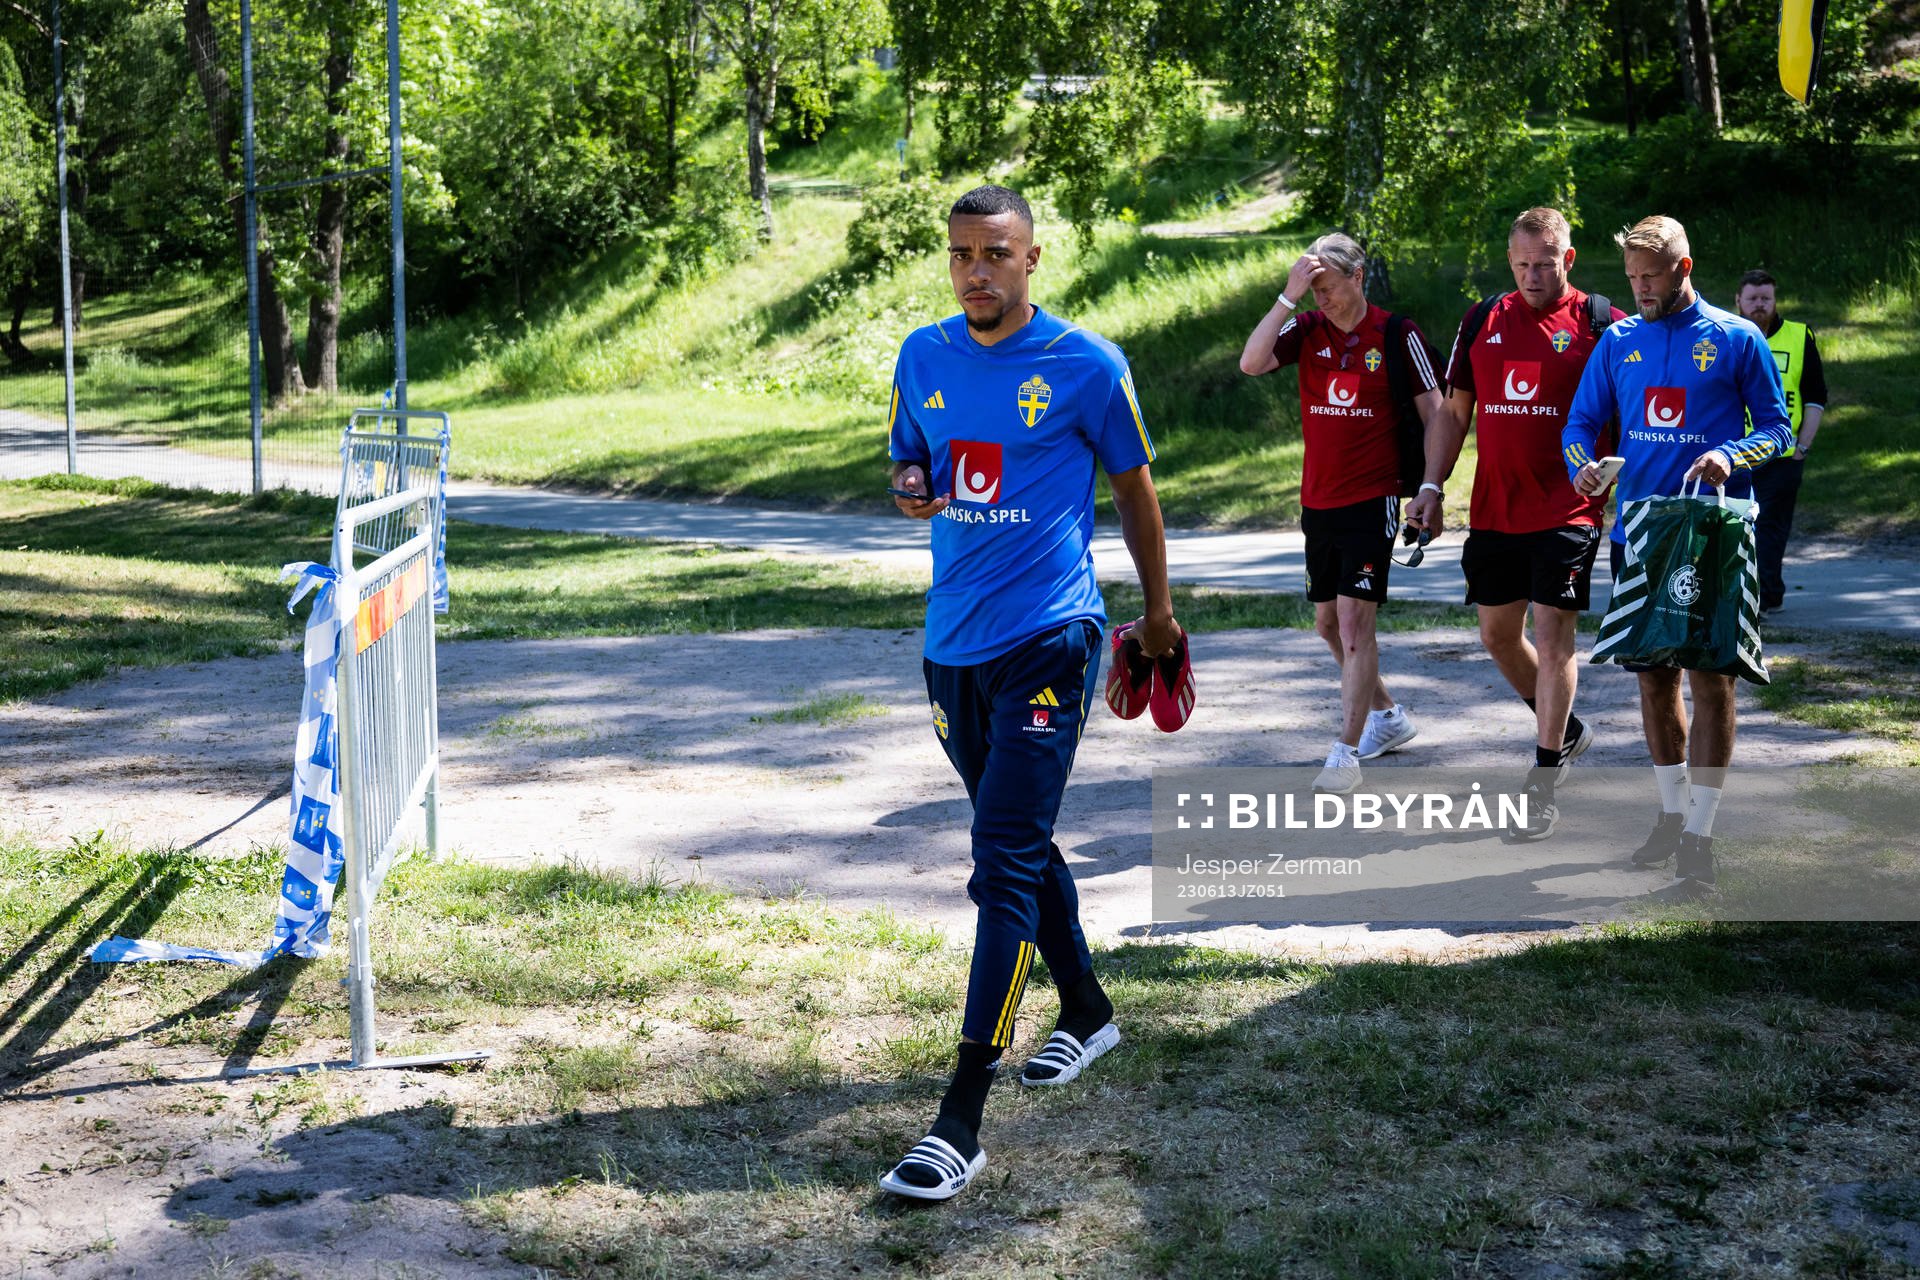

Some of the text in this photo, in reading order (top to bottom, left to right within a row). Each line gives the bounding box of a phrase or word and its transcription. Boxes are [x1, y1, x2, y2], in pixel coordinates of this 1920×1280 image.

[1309, 405, 1374, 417] SVENSKA SPEL
[1484, 404, 1559, 416] SVENSKA SPEL
[1628, 430, 1708, 443] SVENSKA SPEL
[989, 508, 1031, 523] SPEL
